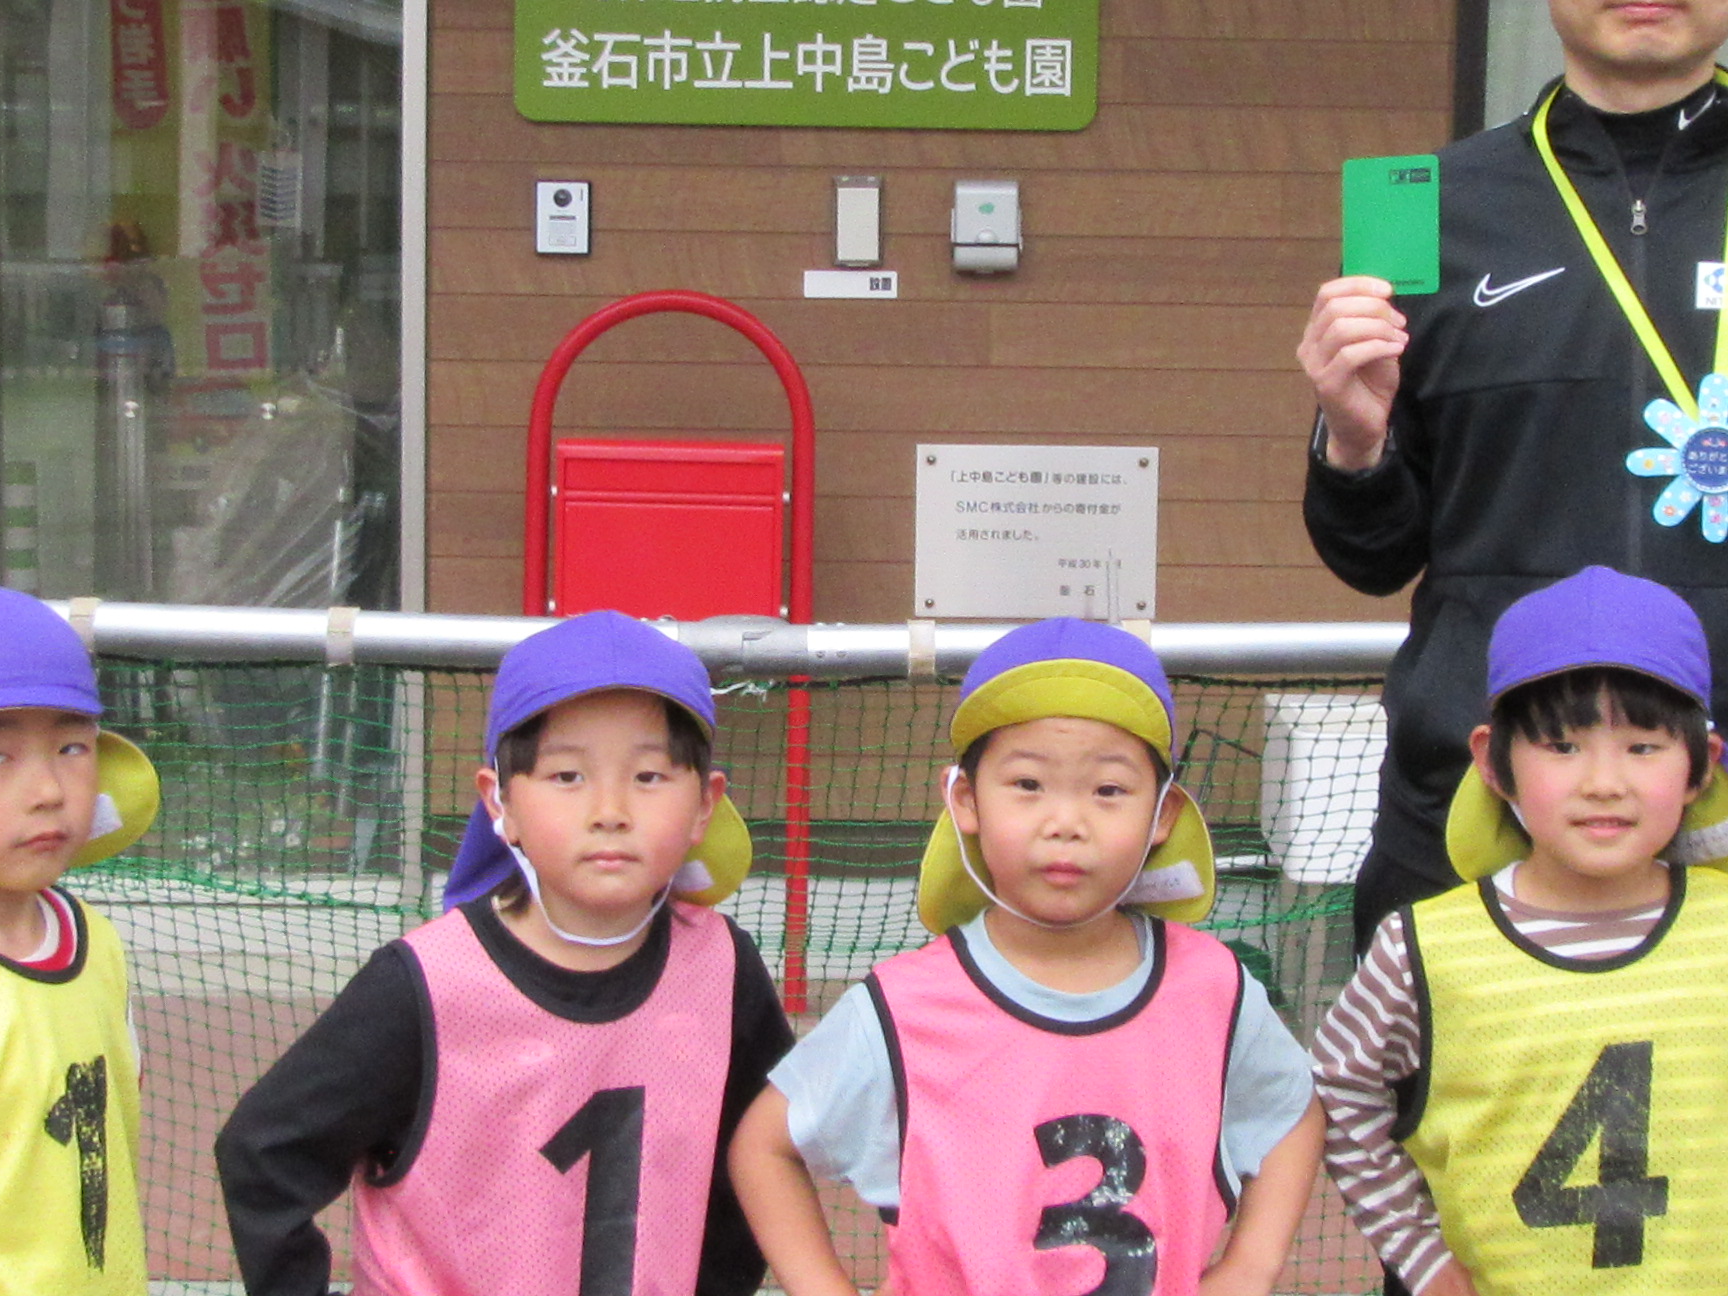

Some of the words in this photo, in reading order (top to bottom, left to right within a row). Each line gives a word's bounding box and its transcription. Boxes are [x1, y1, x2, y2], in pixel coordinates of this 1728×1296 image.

[540, 28, 1073, 96] 釜石市立上中島こども園
[44, 1055, 106, 1273] 1
[1511, 1040, 1669, 1271] 4
